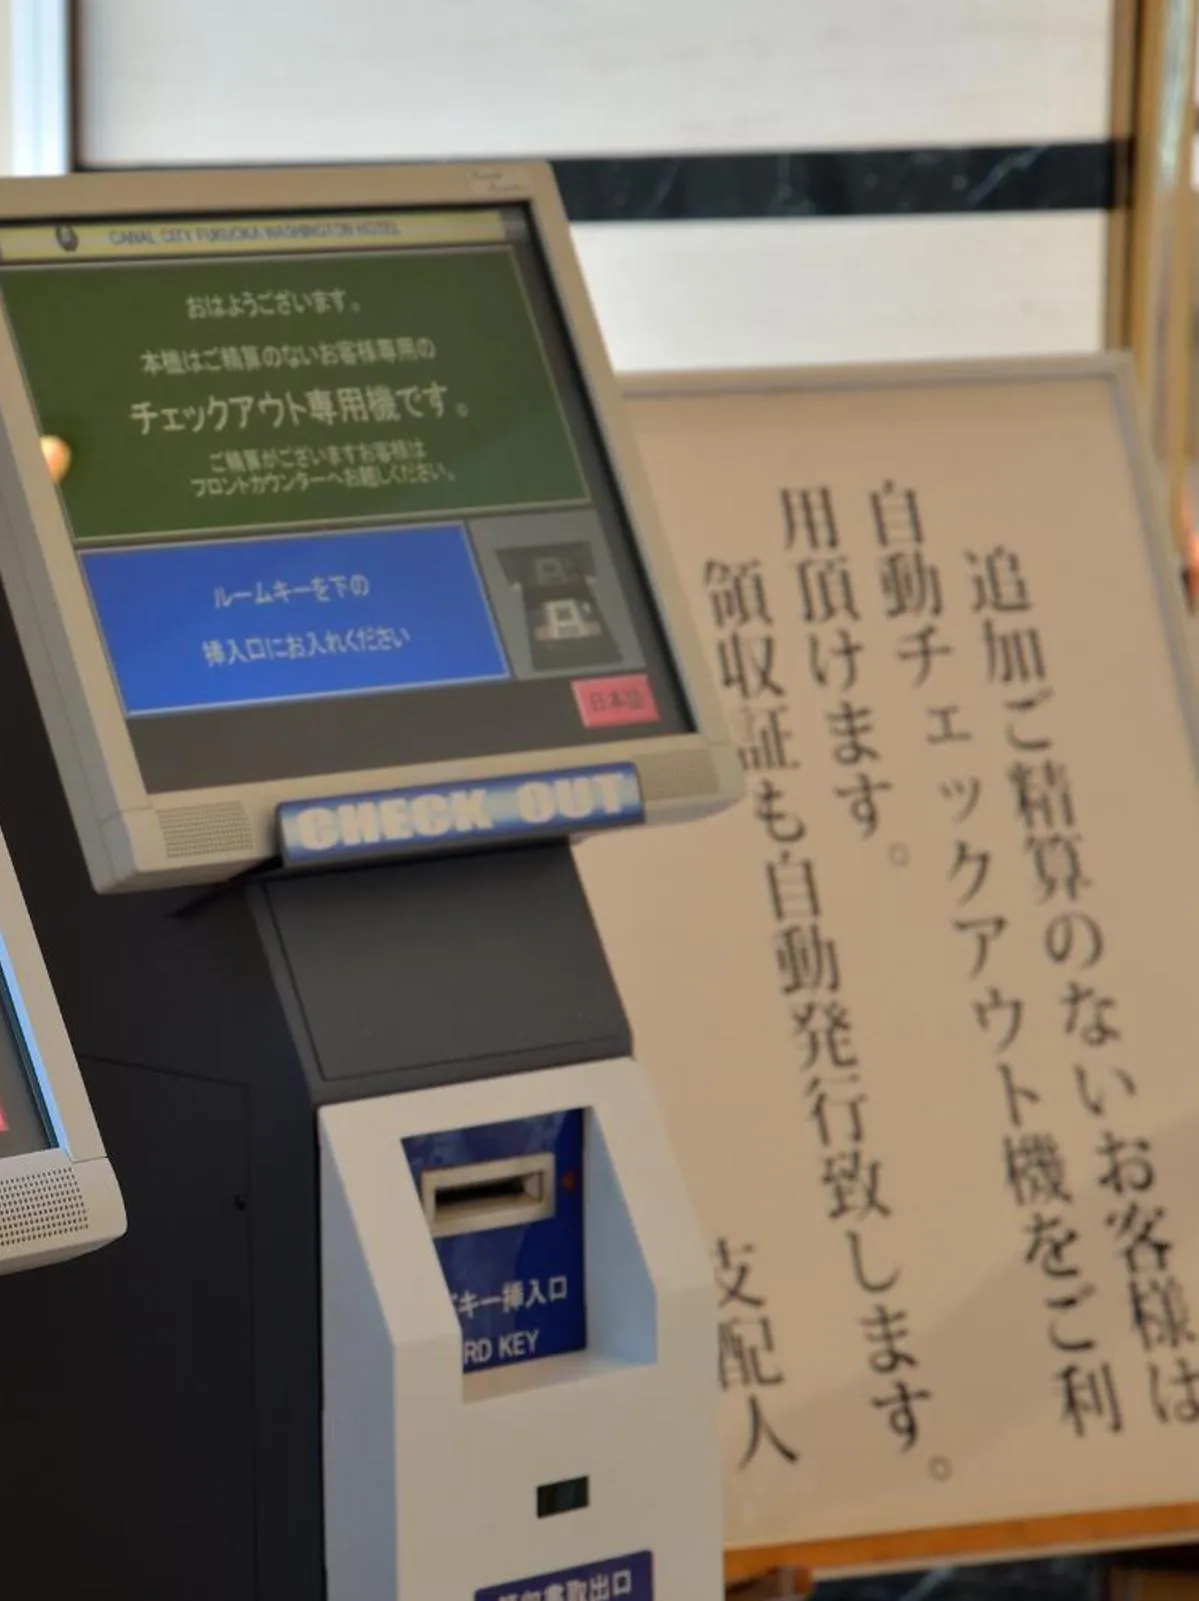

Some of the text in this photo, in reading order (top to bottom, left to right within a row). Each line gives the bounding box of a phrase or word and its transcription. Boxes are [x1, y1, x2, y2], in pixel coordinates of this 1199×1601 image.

[297, 774, 625, 851] CHECK OUT
[451, 1275, 568, 1319] キー挿入口
[463, 1328, 539, 1366] RD KEY
[711, 1237, 798, 1472] 支配人
